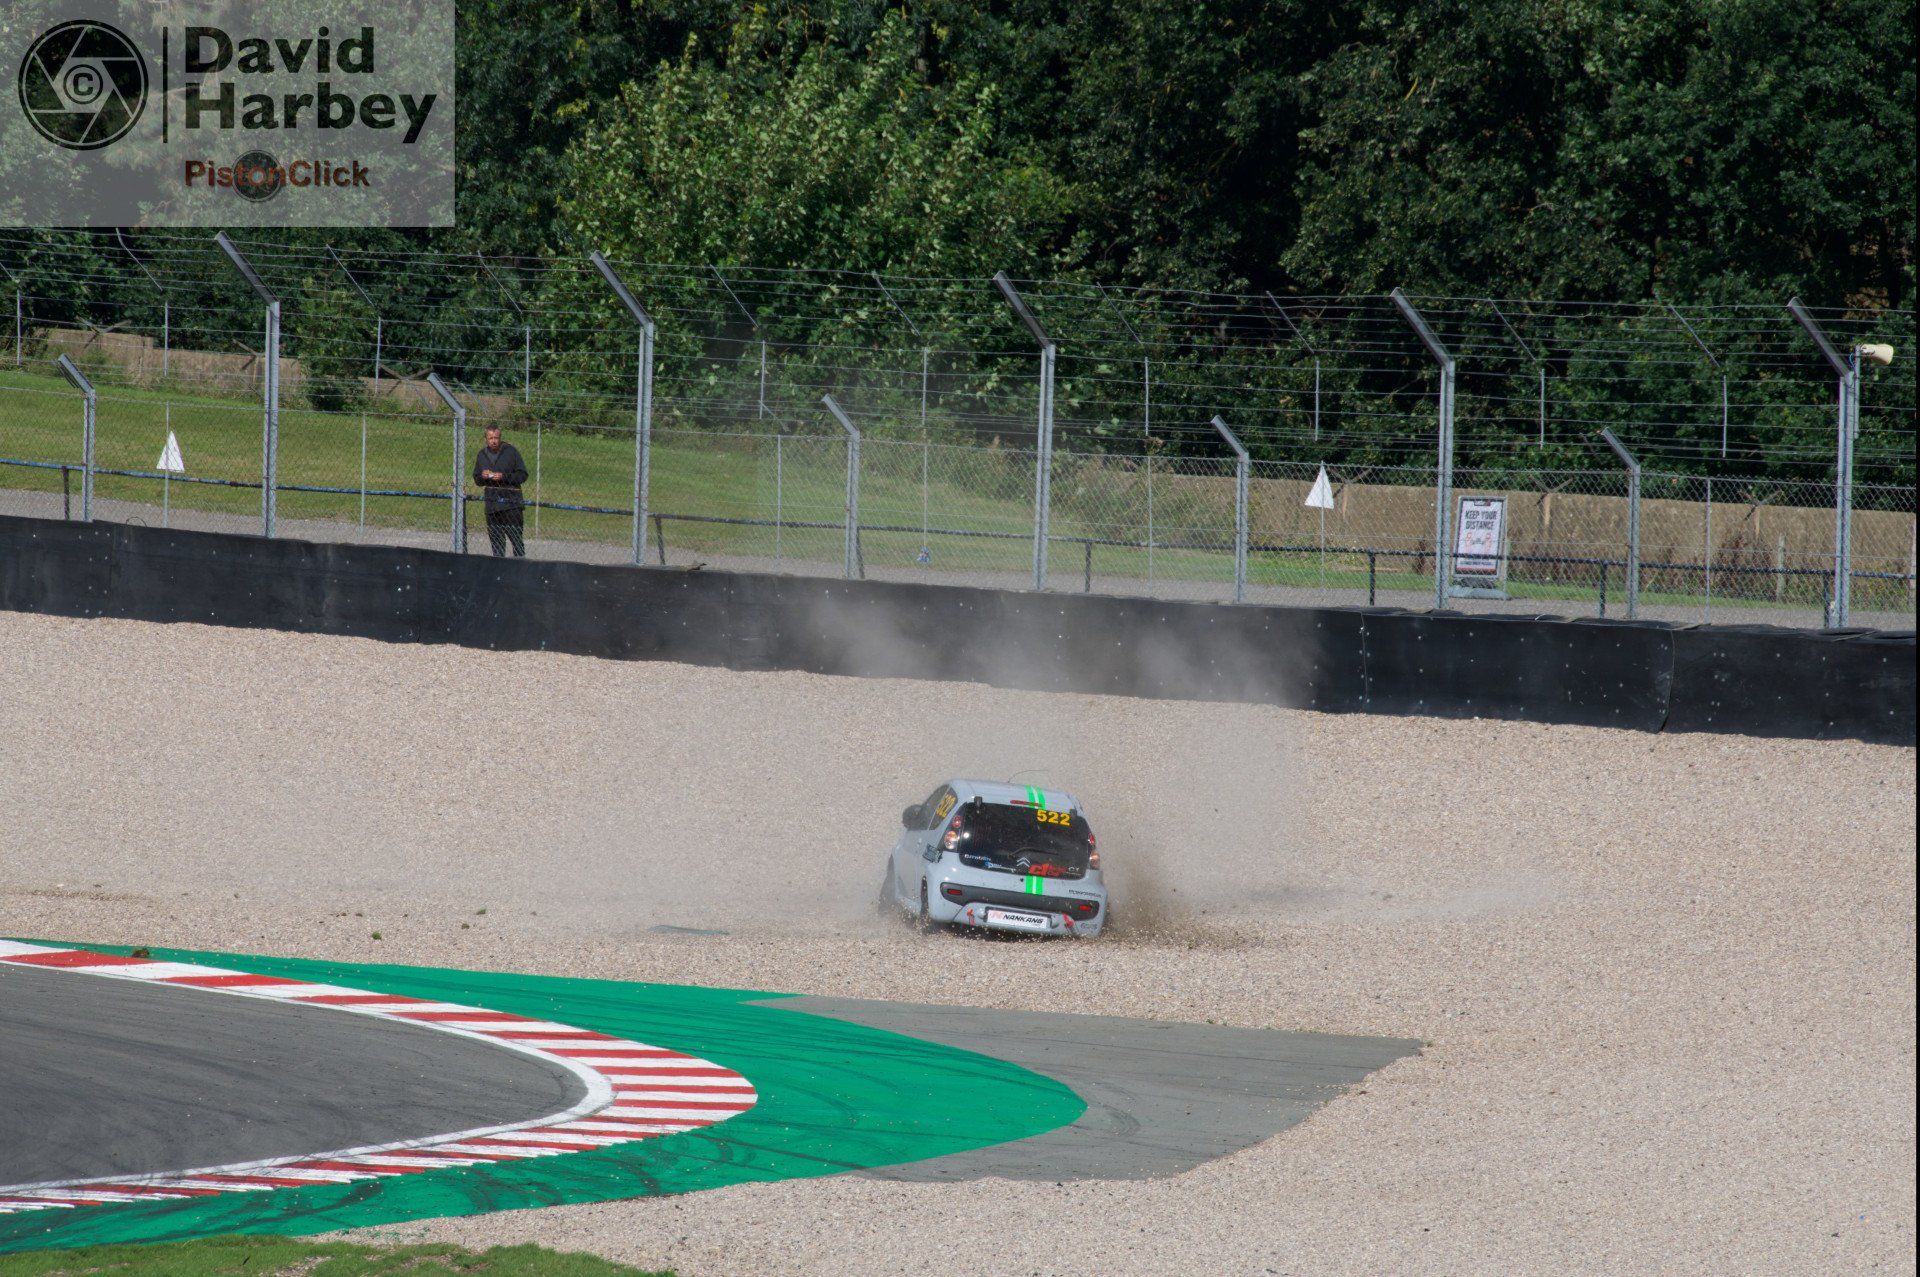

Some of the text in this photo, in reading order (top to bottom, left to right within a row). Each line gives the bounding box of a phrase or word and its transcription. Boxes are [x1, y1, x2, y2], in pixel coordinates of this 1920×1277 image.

[1465, 511, 1497, 520] KEEP YOUR
[1466, 521, 1495, 530] DISTANCE
[1037, 810, 1070, 826] 522
[1002, 914, 1044, 924] NANKANG
